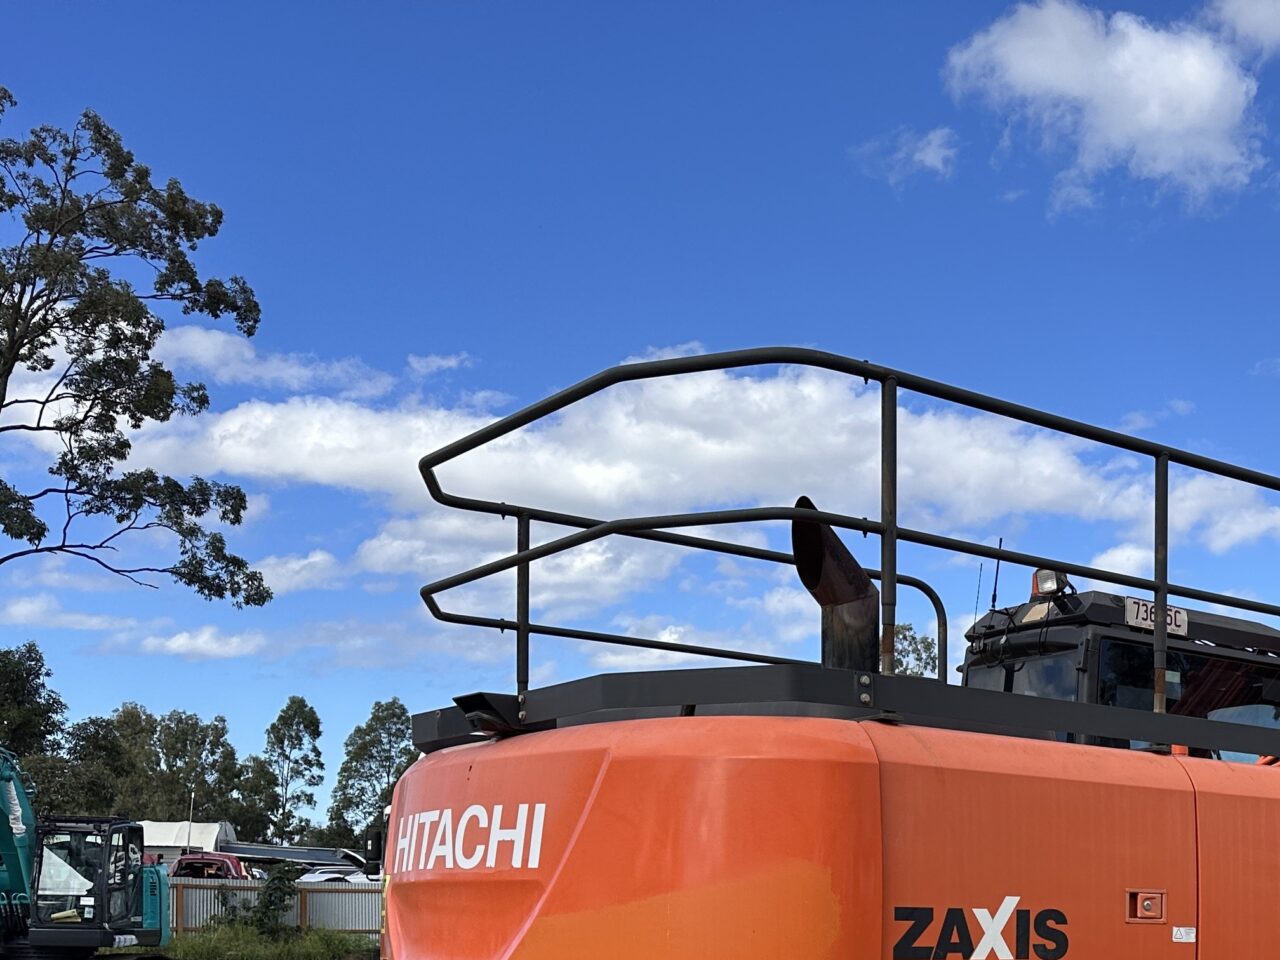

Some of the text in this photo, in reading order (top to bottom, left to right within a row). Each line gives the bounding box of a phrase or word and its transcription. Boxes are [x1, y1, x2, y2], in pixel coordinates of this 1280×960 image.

[1133, 601, 1182, 629] 7365C
[394, 803, 546, 874] HITACHI
[893, 896, 1070, 960] ZAXIS
